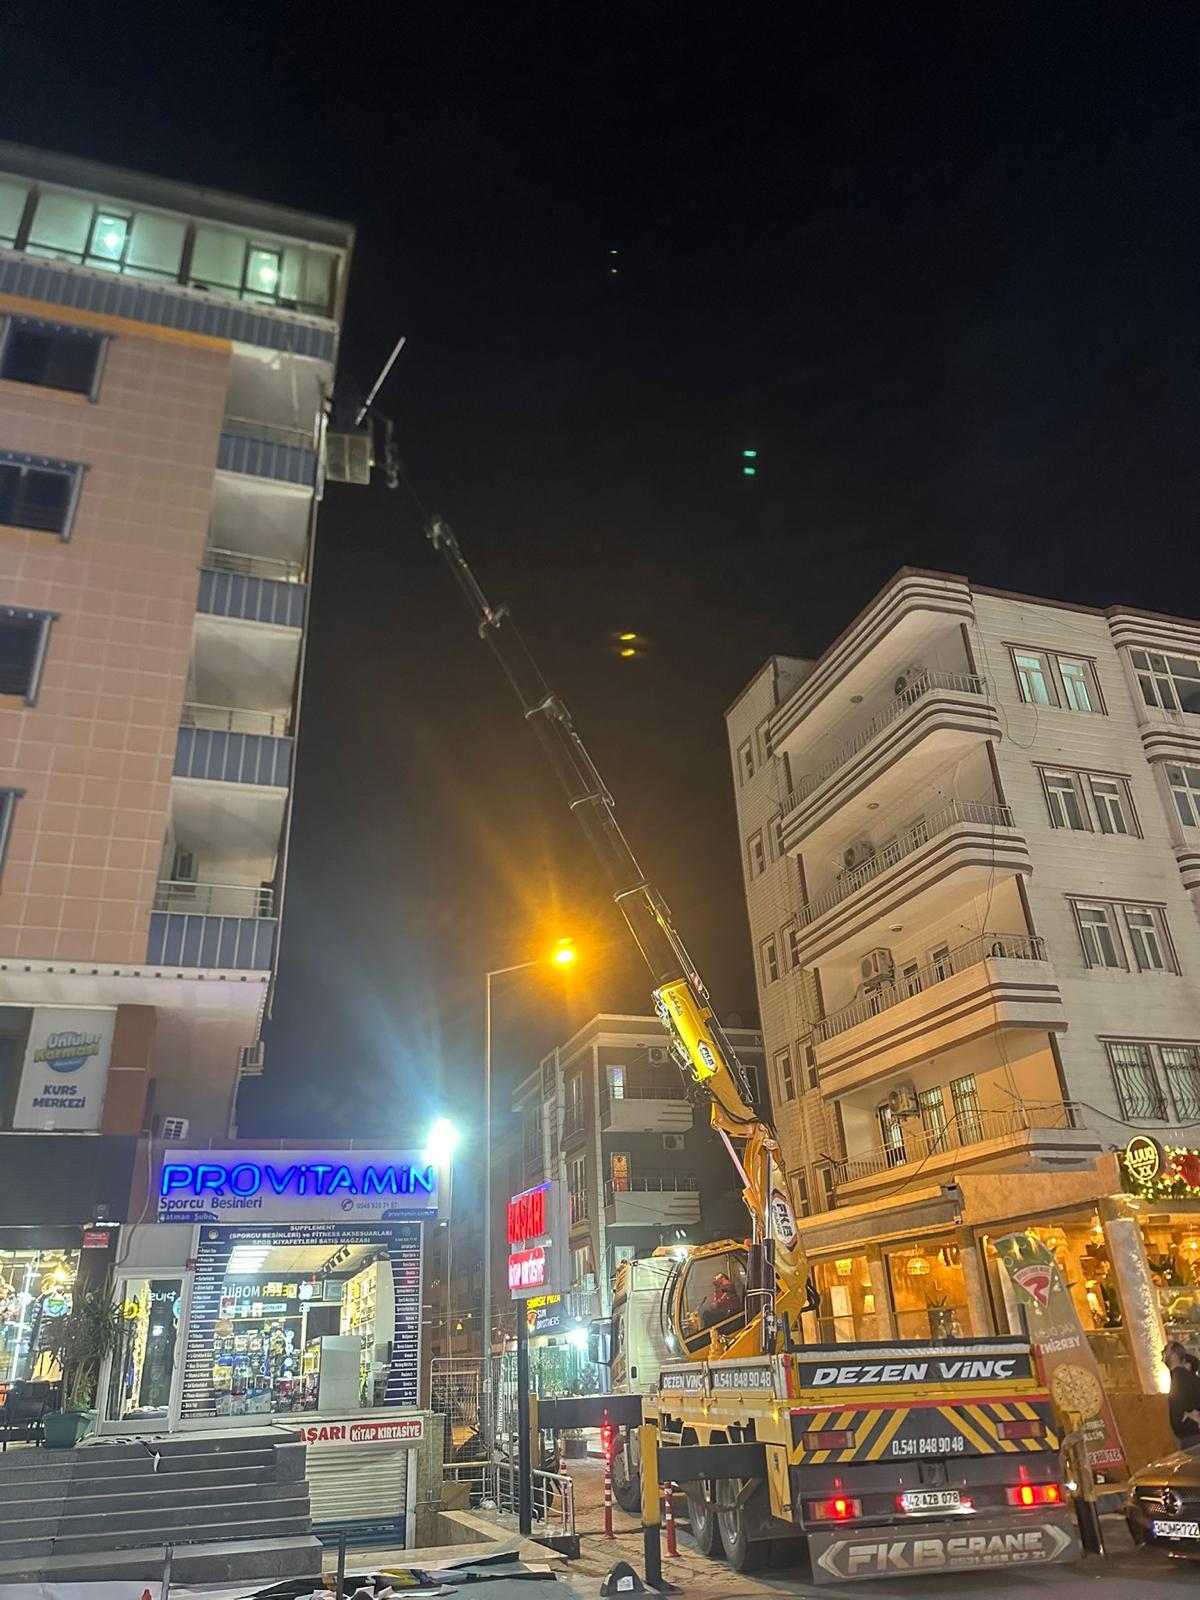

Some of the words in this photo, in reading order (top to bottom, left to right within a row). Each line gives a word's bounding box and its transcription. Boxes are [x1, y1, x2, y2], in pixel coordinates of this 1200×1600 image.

[43, 1084, 77, 1095] KURS
[32, 1097, 86, 1108] MERKEZİ
[160, 1197, 204, 1211] Sporcu
[211, 1196, 263, 1208] Besinleri
[760, 1371, 772, 1386] 48
[812, 1363, 929, 1386] DEZEN
[939, 1360, 1016, 1379] VİNÇ
[663, 1376, 685, 1389] DEZEN
[352, 1427, 376, 1441] KİTAP
[377, 1422, 420, 1439] KIRTASİYE
[892, 1439, 917, 1455] 0.541
[919, 1437, 937, 1453] 848
[938, 1437, 951, 1452] 90
[951, 1436, 964, 1451] 48
[922, 1494, 939, 1505] AZB
[941, 1492, 959, 1504] 078
[848, 1539, 945, 1574] FKB
[946, 1531, 1042, 1556] CRANE
